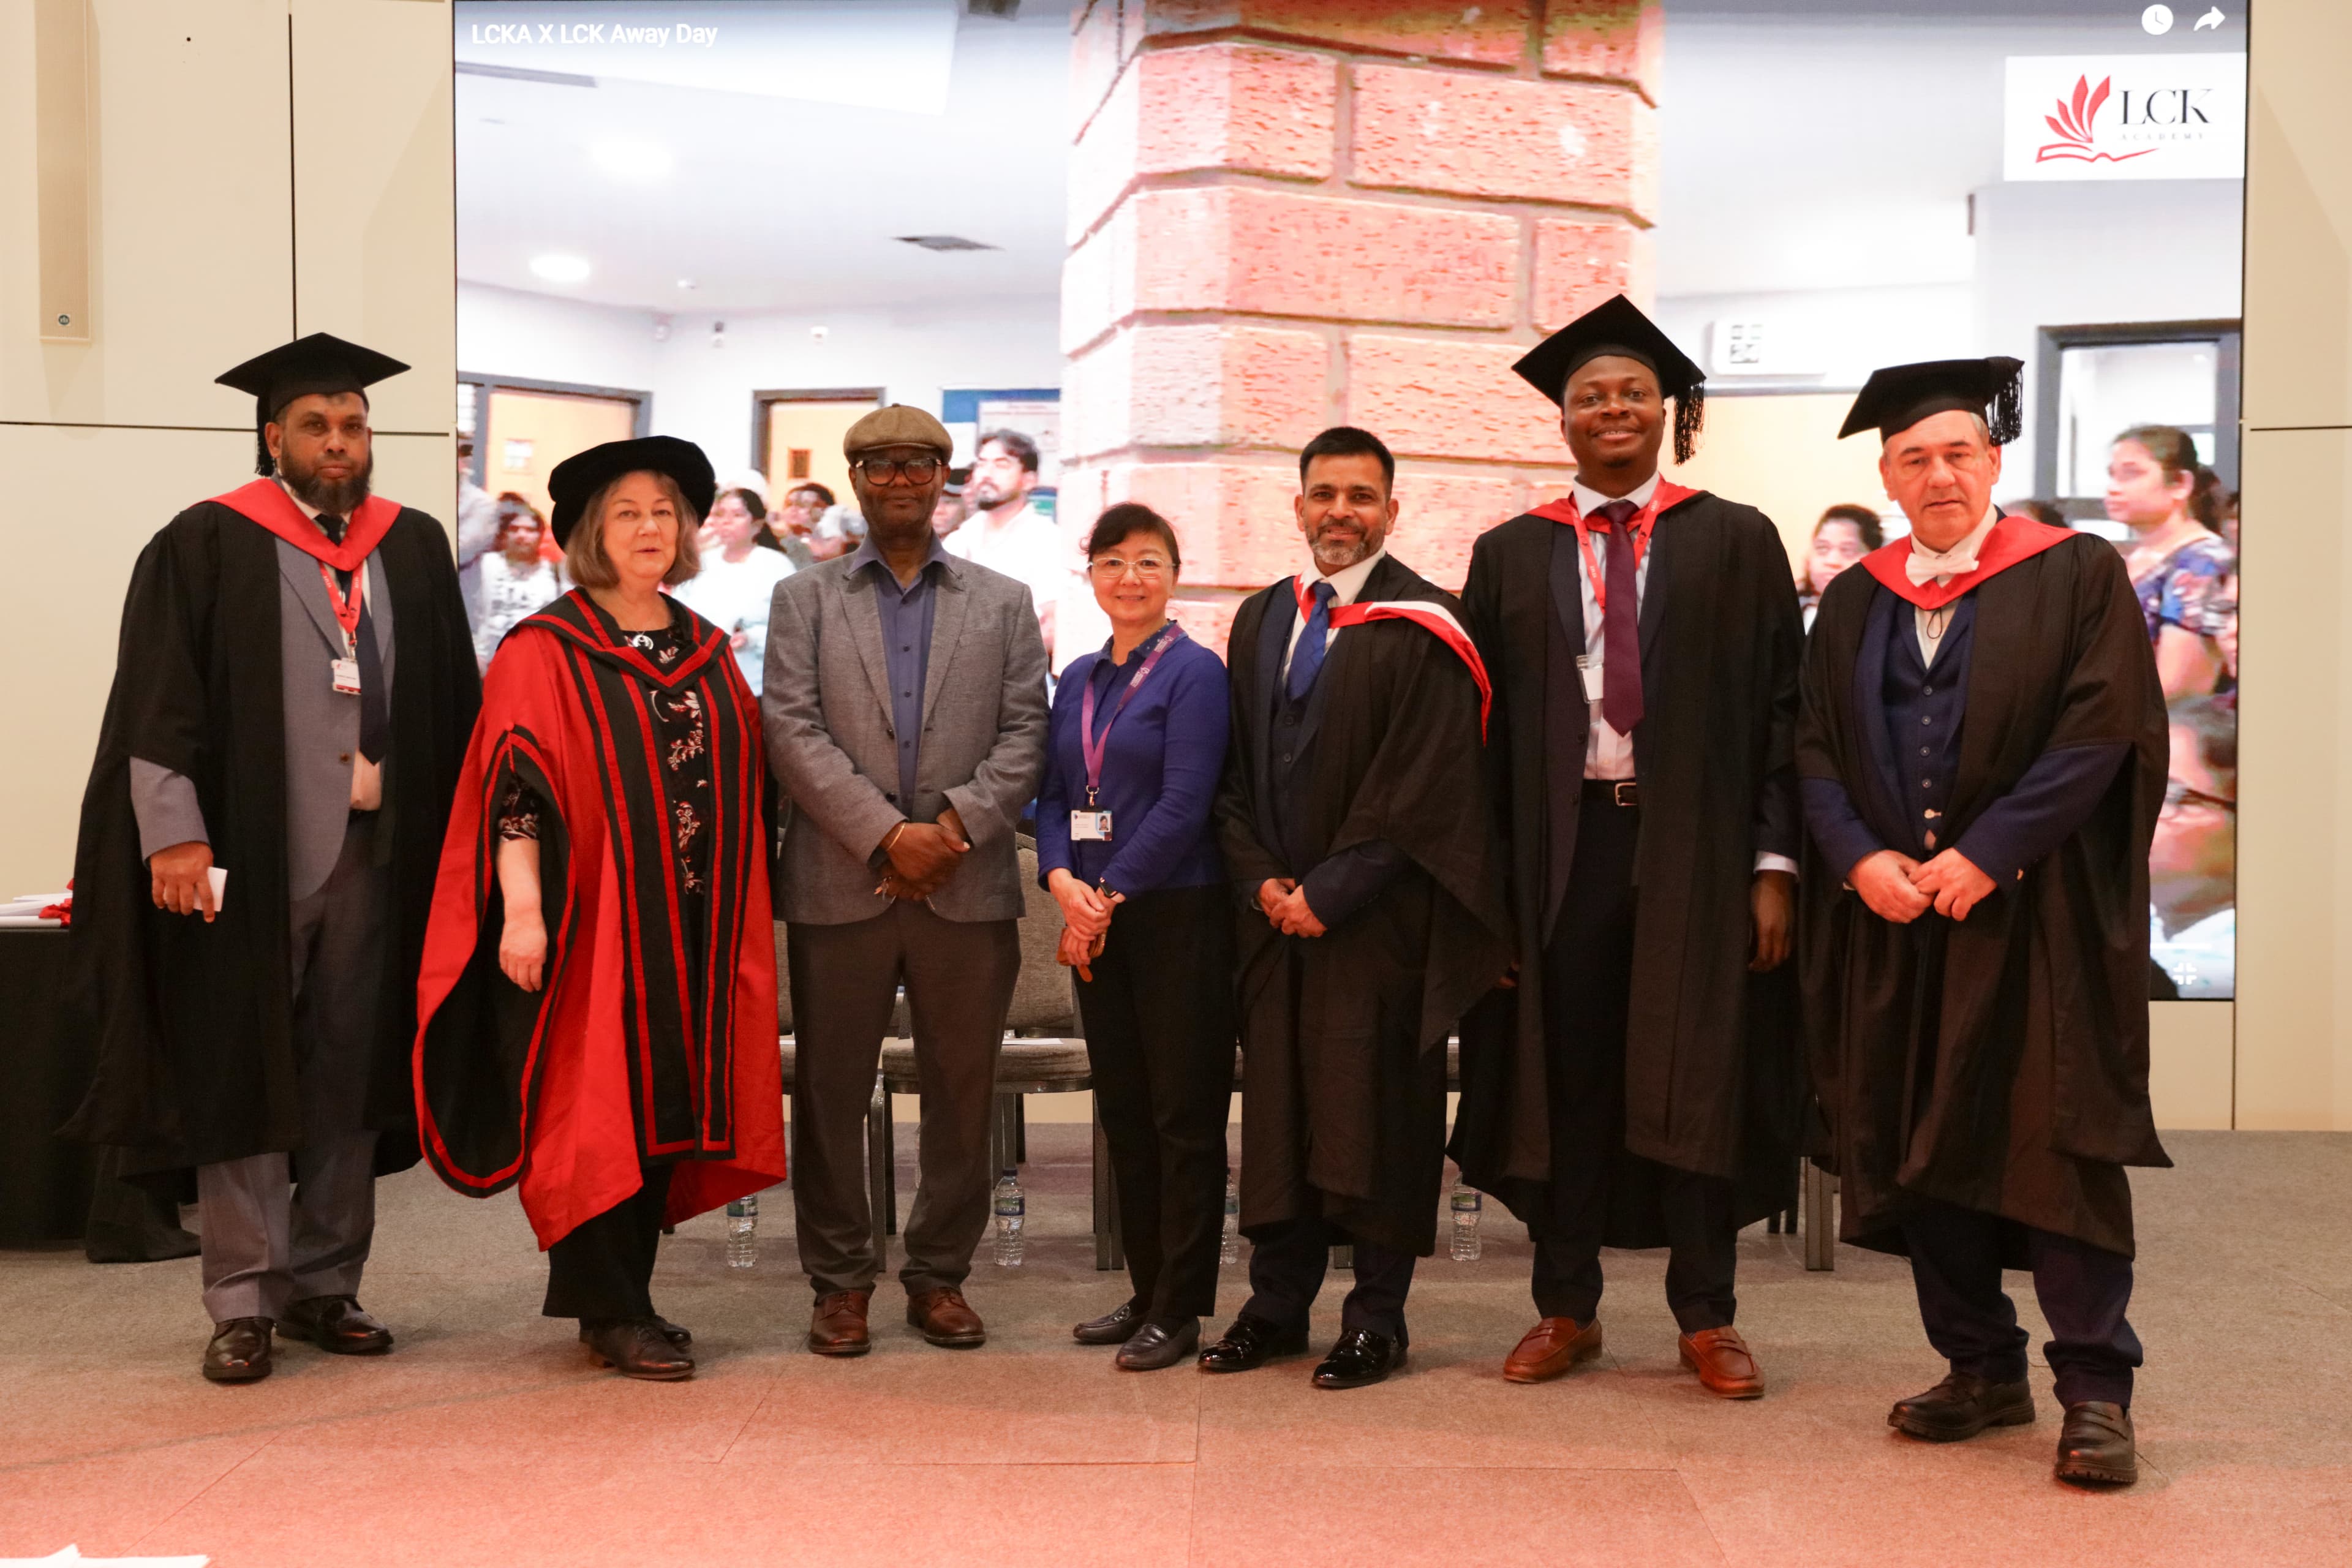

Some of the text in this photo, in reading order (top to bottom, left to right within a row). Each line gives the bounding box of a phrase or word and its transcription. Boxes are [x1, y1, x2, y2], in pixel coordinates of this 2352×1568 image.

[472, 24, 717, 47] LCKA X LCK Away Day
[2119, 89, 2213, 124] LCK
